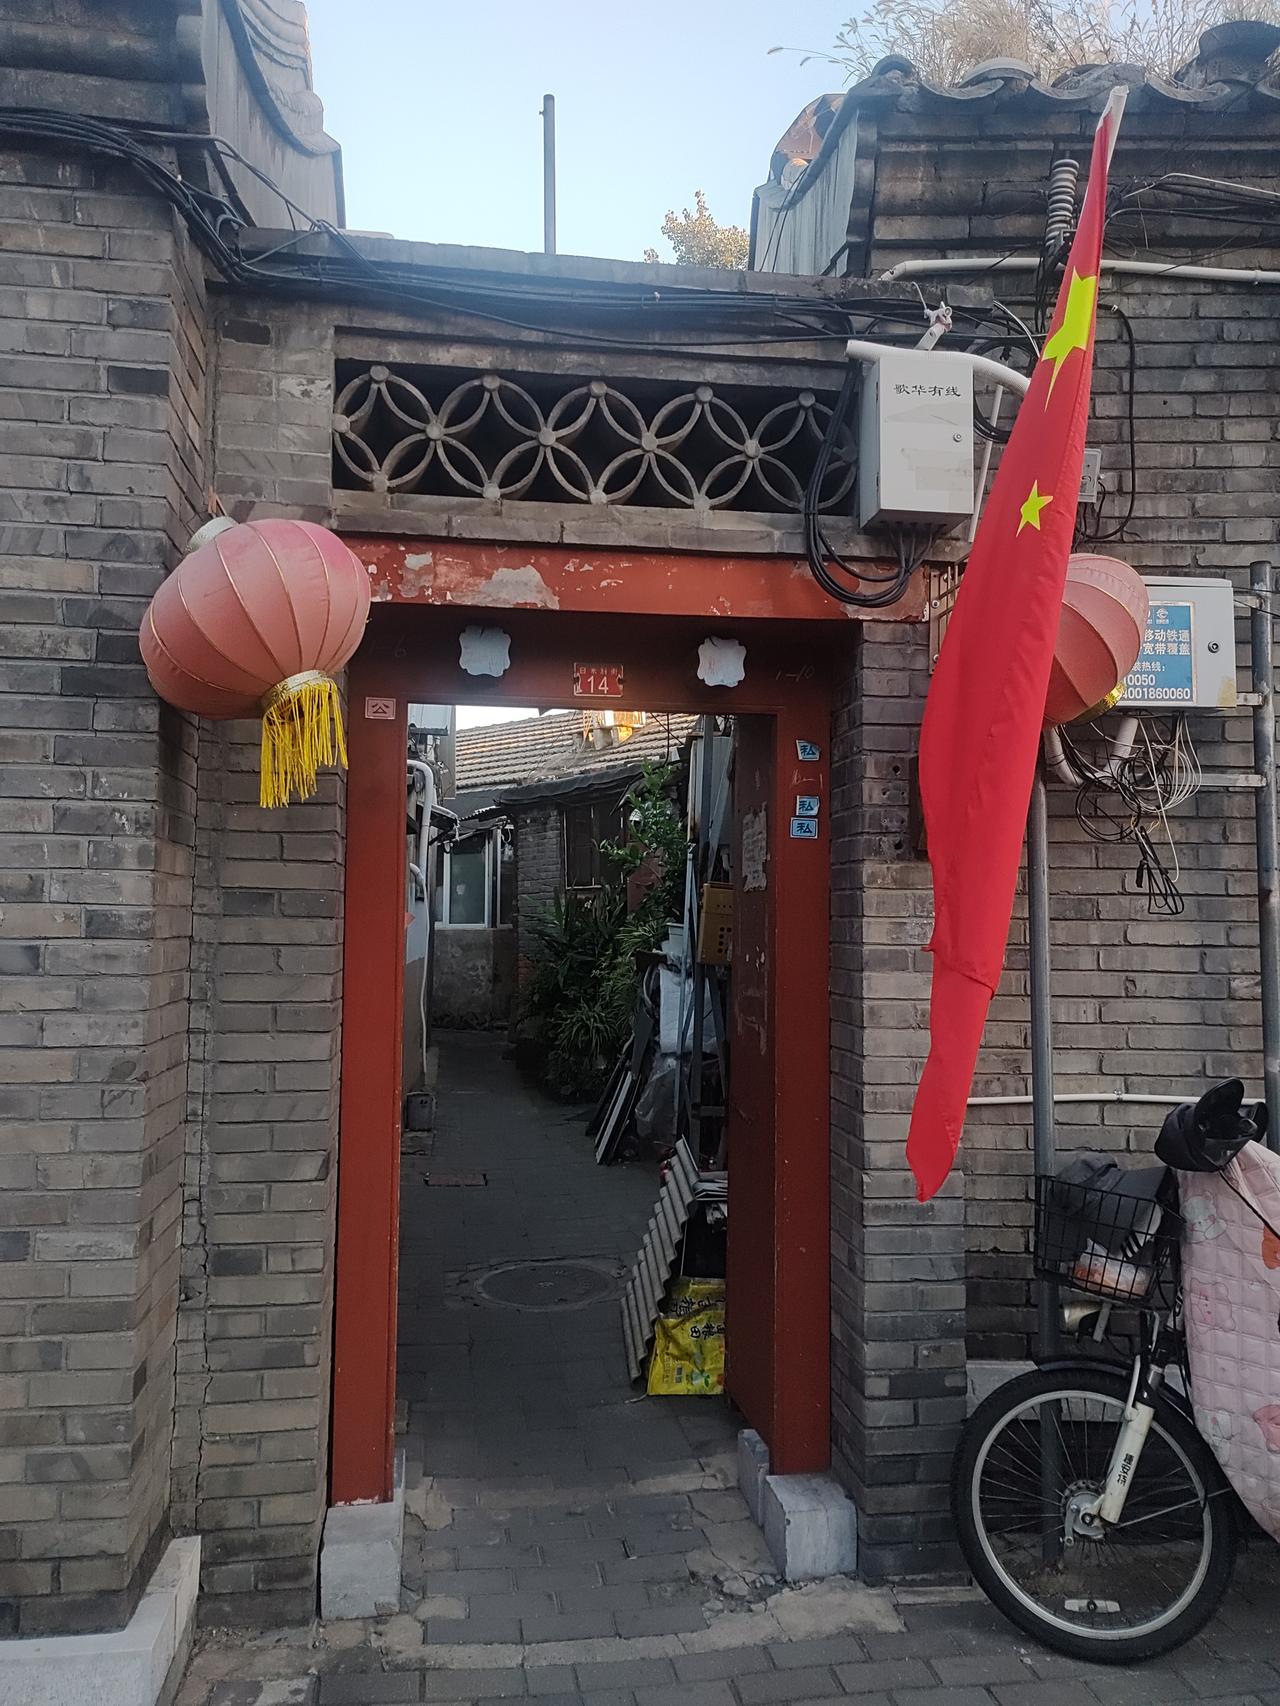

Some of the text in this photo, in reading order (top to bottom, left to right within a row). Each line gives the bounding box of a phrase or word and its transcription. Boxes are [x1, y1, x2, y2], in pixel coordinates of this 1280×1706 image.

[894, 384, 961, 397] 歌华有线
[1144, 629, 1190, 641] 移动铁通
[1142, 642, 1190, 655] 宽带覆盖
[587, 675, 609, 694] 14
[372, 702, 390, 714] 公
[800, 744, 816, 756] 私
[799, 800, 814, 812] 私
[796, 822, 813, 834] 私
